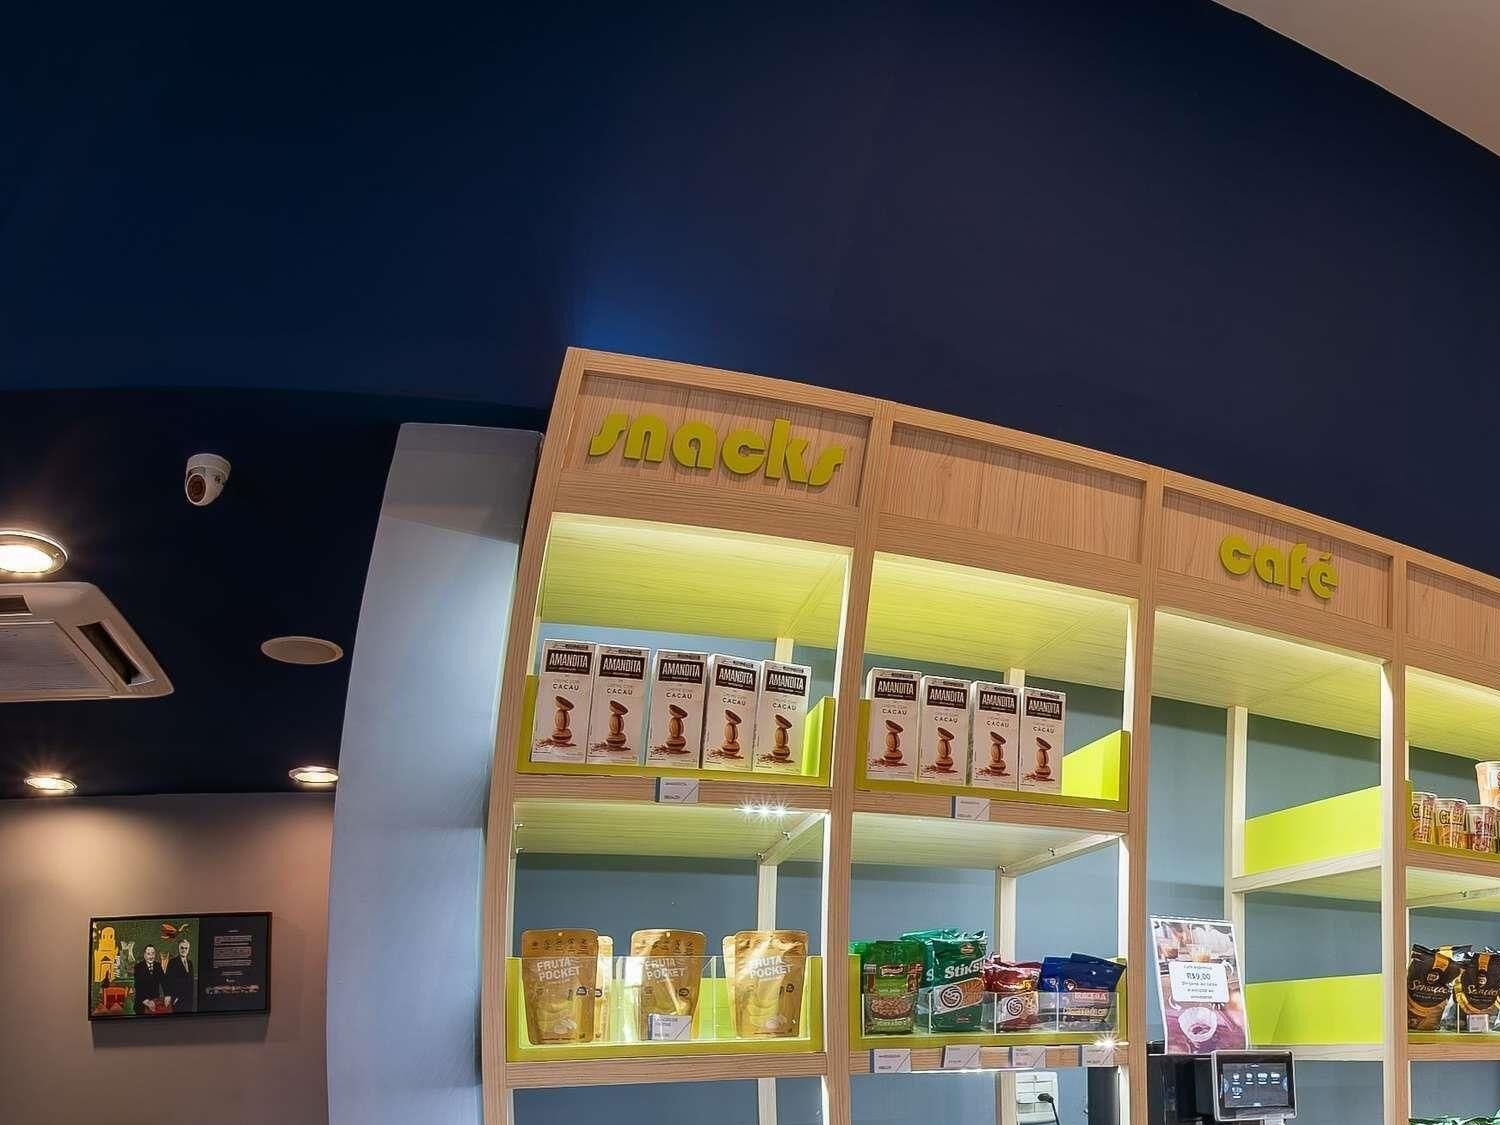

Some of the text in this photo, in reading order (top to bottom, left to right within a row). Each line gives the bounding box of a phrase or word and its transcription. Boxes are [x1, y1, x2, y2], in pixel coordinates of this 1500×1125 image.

[588, 413, 847, 489] snacks
[1219, 534, 1340, 601] café
[550, 651, 589, 668] AMANDITA
[602, 656, 642, 673] AMANDITA
[662, 661, 701, 678] AMANDITA
[718, 667, 754, 686] AMANDITA
[552, 682, 580, 692] CACAU
[768, 672, 805, 690] AMANDITA
[877, 679, 914, 696] AMANDITA
[606, 686, 633, 696] CACAU
[666, 691, 693, 700] CACAU
[929, 687, 965, 705] AMANDITA
[722, 696, 747, 706] CACAU
[772, 702, 797, 712] CACAU
[981, 693, 1015, 710] AMANDITA
[1028, 699, 1060, 716] AMANDITA
[882, 708, 907, 716] CACAU
[933, 715, 958, 724] CACAU
[986, 719, 1010, 728] CACAU
[1032, 726, 1055, 735] CACAU
[538, 965, 580, 982] POCKET
